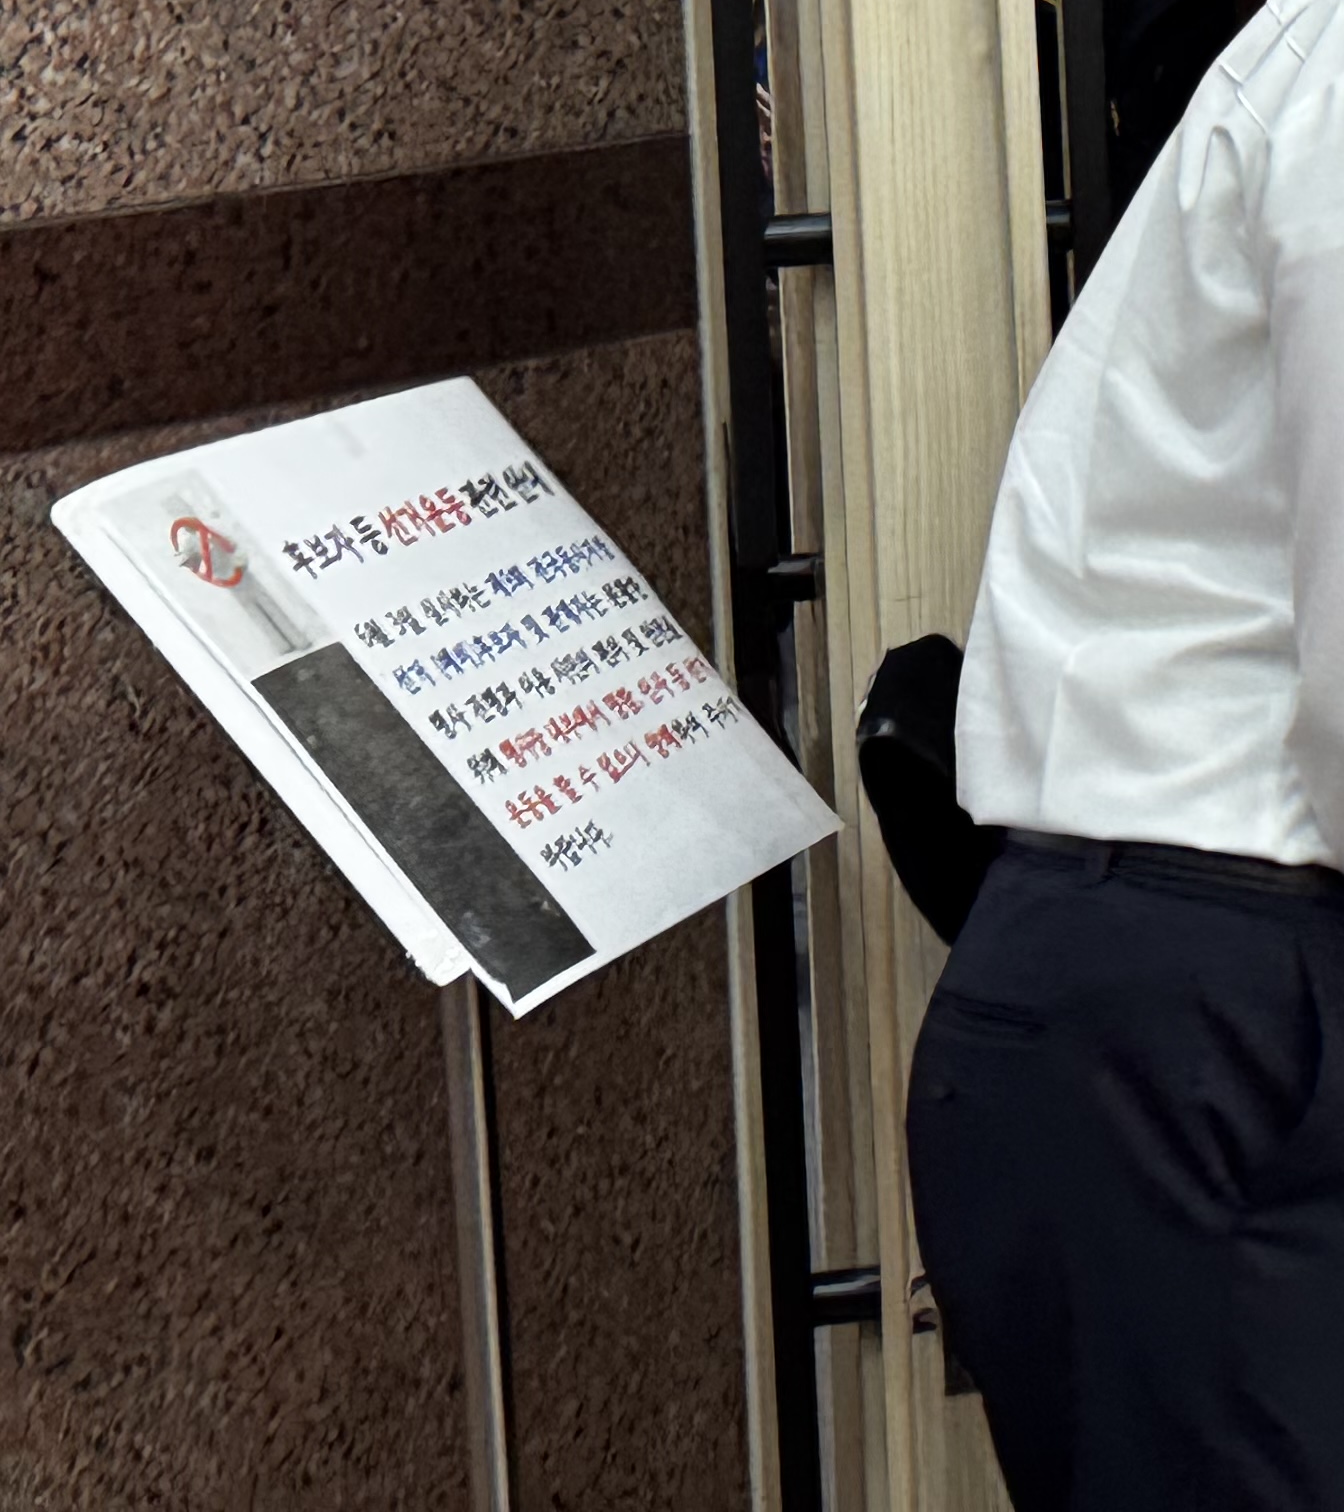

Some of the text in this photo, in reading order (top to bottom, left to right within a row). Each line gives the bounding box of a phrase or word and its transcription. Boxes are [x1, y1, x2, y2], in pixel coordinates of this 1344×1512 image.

[282, 524, 364, 580] 후보자
[349, 515, 389, 556] 등
[378, 486, 473, 547] 선거운동
